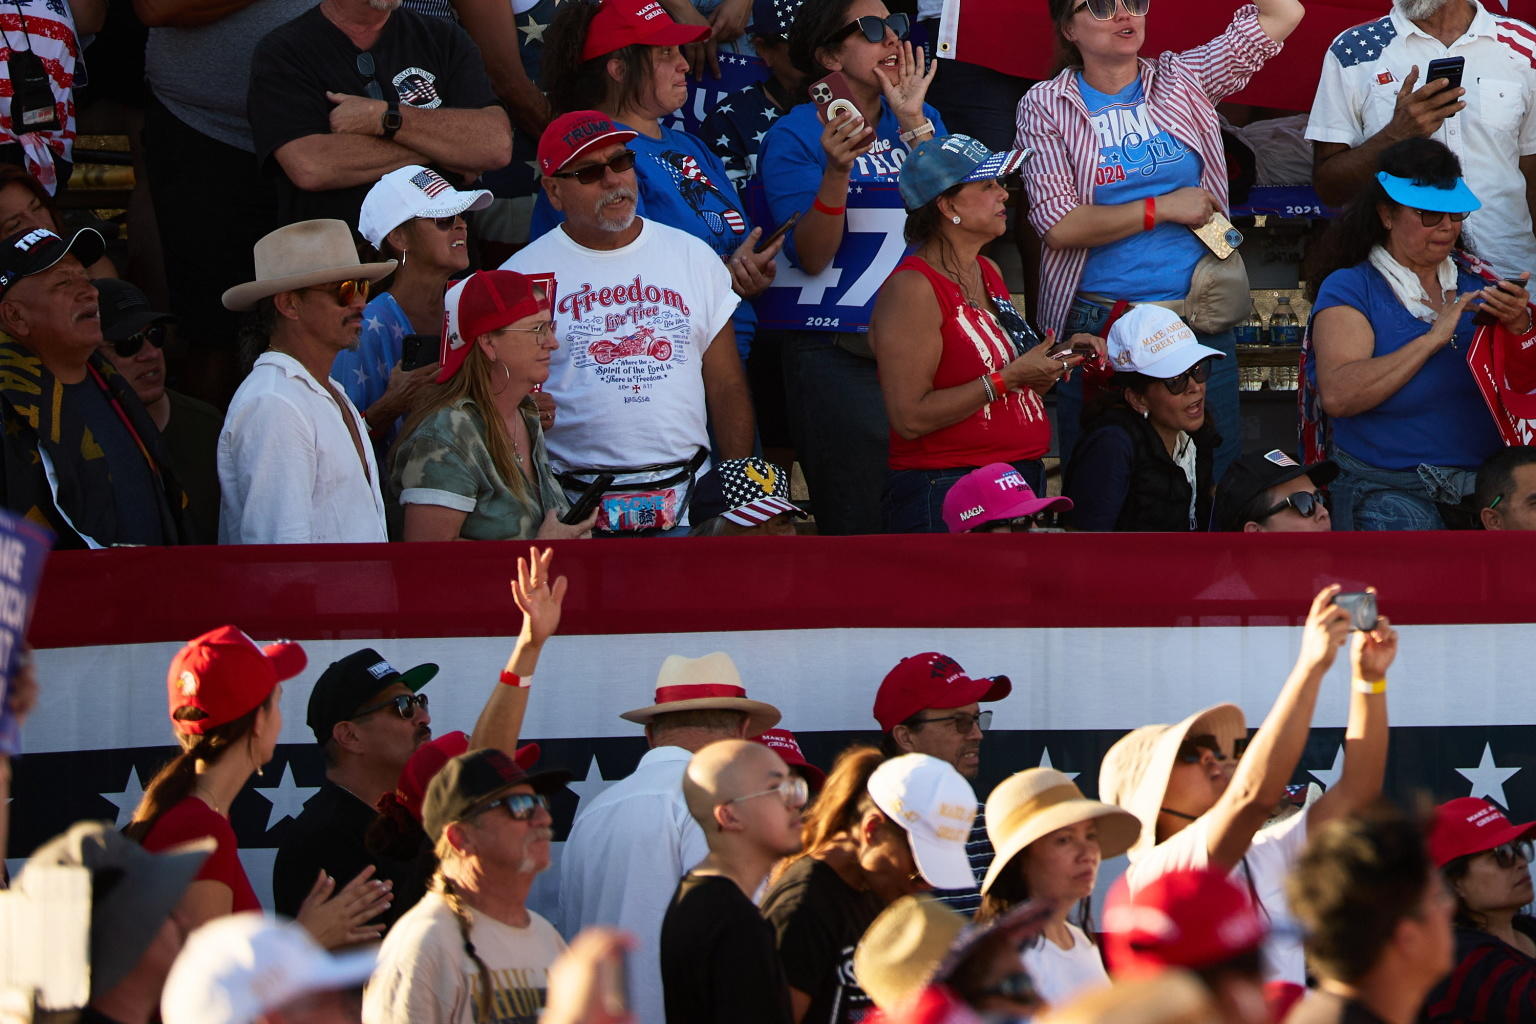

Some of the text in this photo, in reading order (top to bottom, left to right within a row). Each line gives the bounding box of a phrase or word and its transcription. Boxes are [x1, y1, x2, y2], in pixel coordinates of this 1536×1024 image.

[562, 120, 610, 148] TRUMP
[1119, 133, 1193, 177] Girl
[558, 275, 691, 323] Freedom
[604, 311, 632, 333] Live
[806, 316, 841, 328] 2024
[959, 505, 986, 523] MAGA
